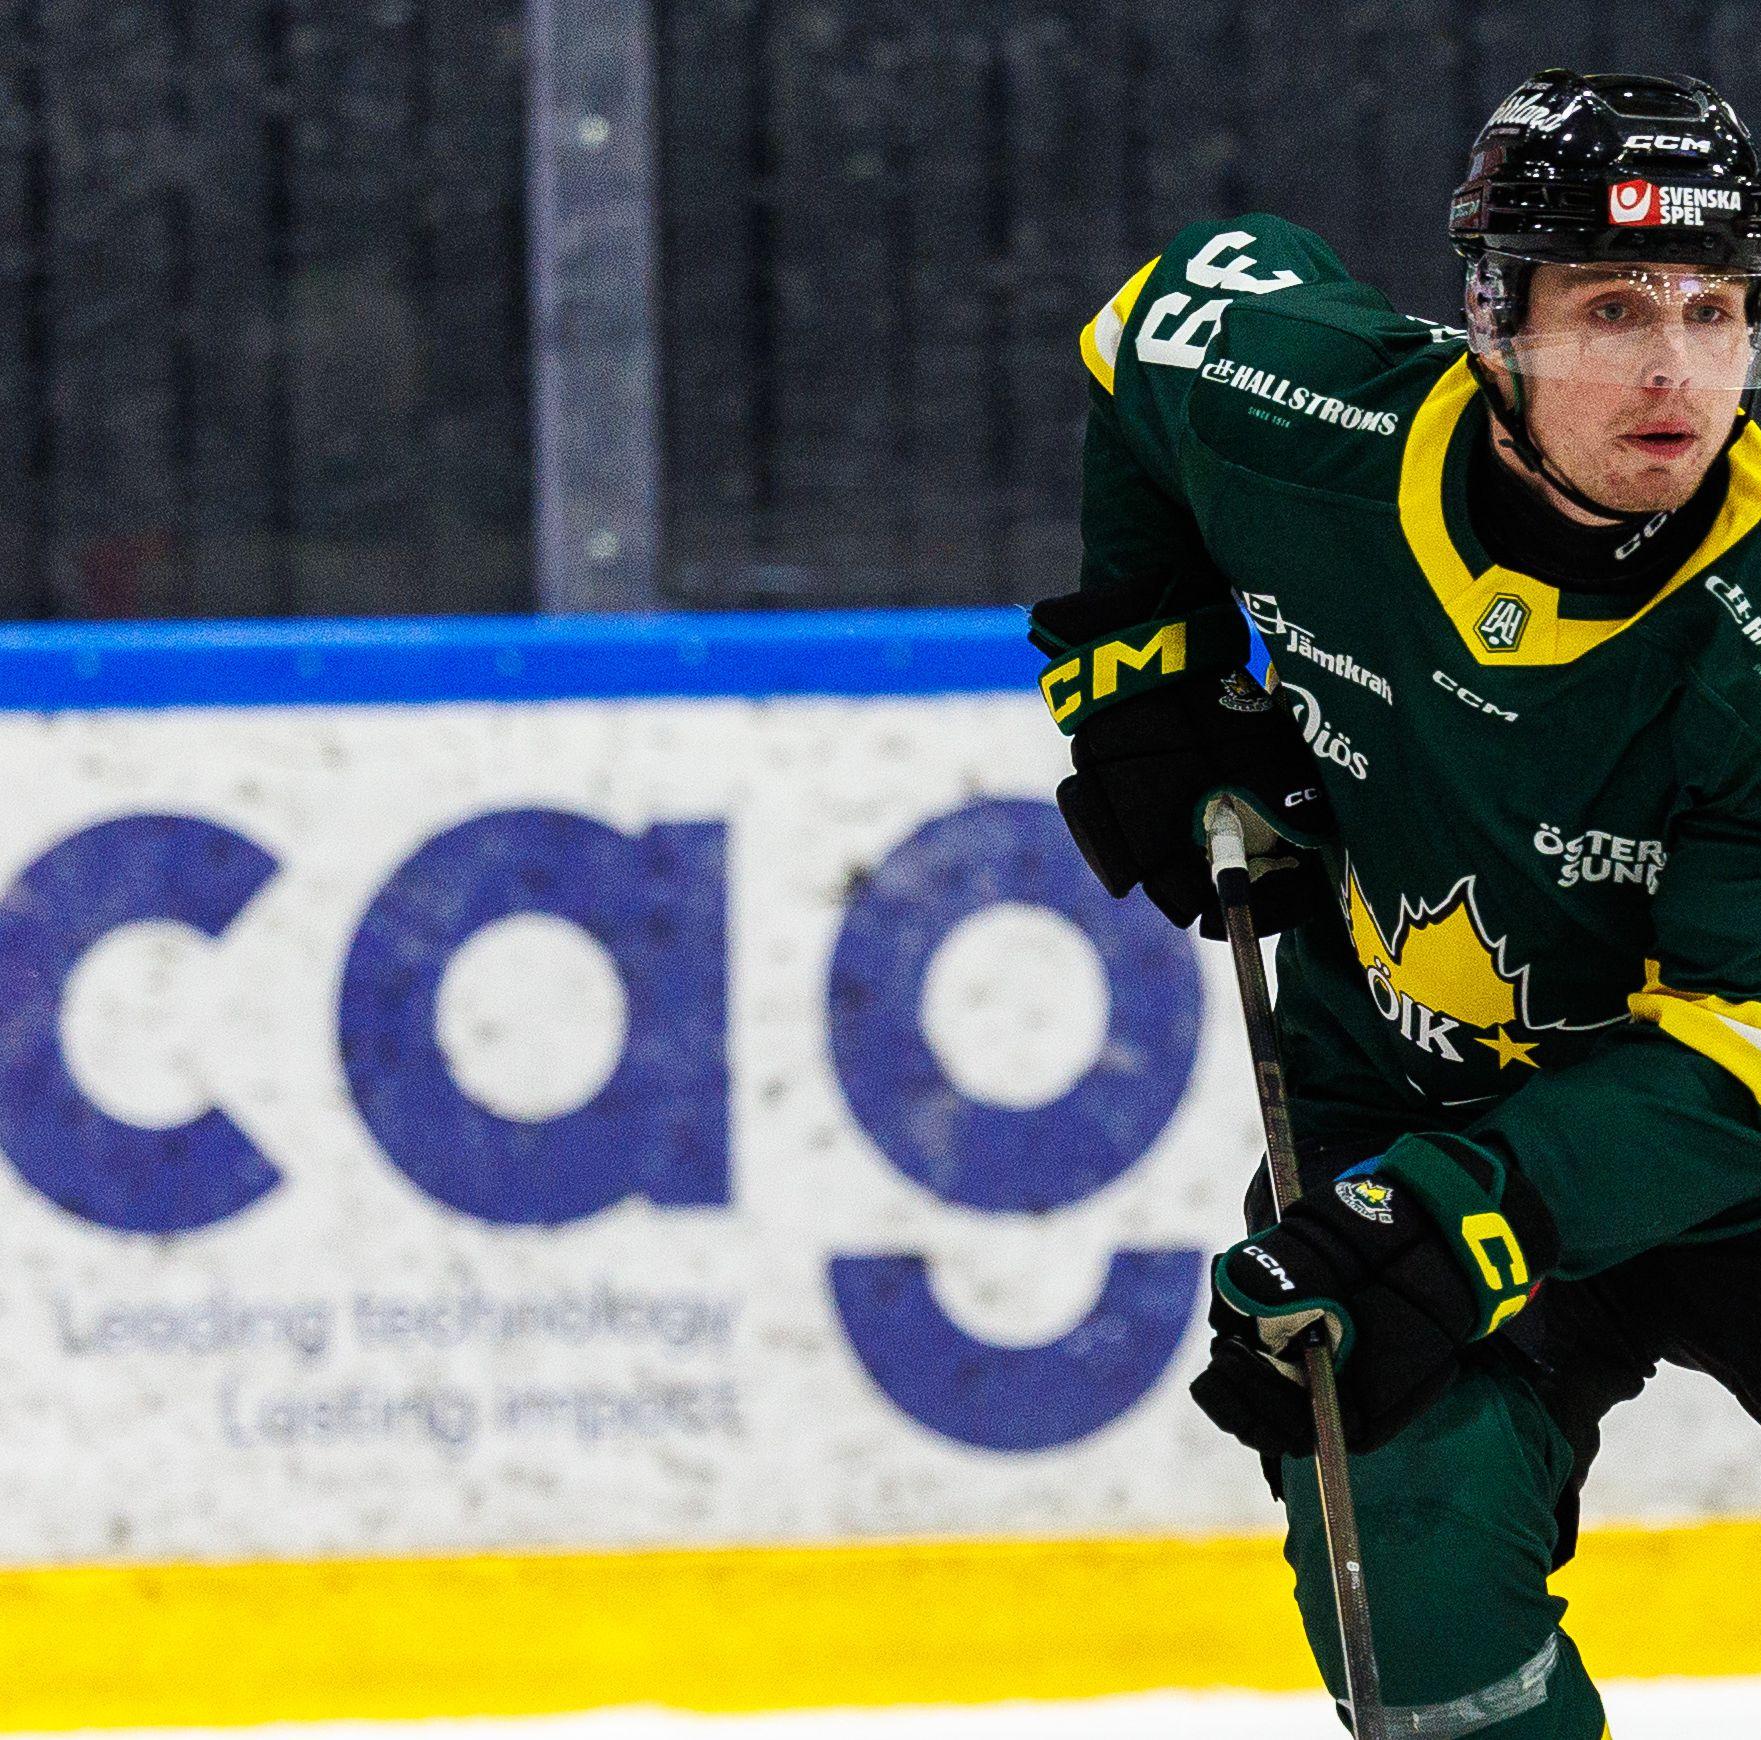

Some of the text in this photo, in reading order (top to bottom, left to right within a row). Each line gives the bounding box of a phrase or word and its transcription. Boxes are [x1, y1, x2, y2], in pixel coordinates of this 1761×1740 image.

[1623, 135, 1712, 153] CCM
[1659, 186, 1742, 211] SVENSKA
[1659, 205, 1704, 226] SPEL
[1135, 230, 1303, 370] 39
[1613, 508, 1677, 561] CC
[1432, 670, 1519, 723] CCM
[1533, 822, 1669, 866] ÖSTER
[1367, 957, 1464, 1063] ÖIK
[0, 797, 1207, 1452] cag
[1243, 1244, 1295, 1292] CCM
[54, 1282, 740, 1366] Leading technology
[220, 1376, 745, 1460] Lasting impact
